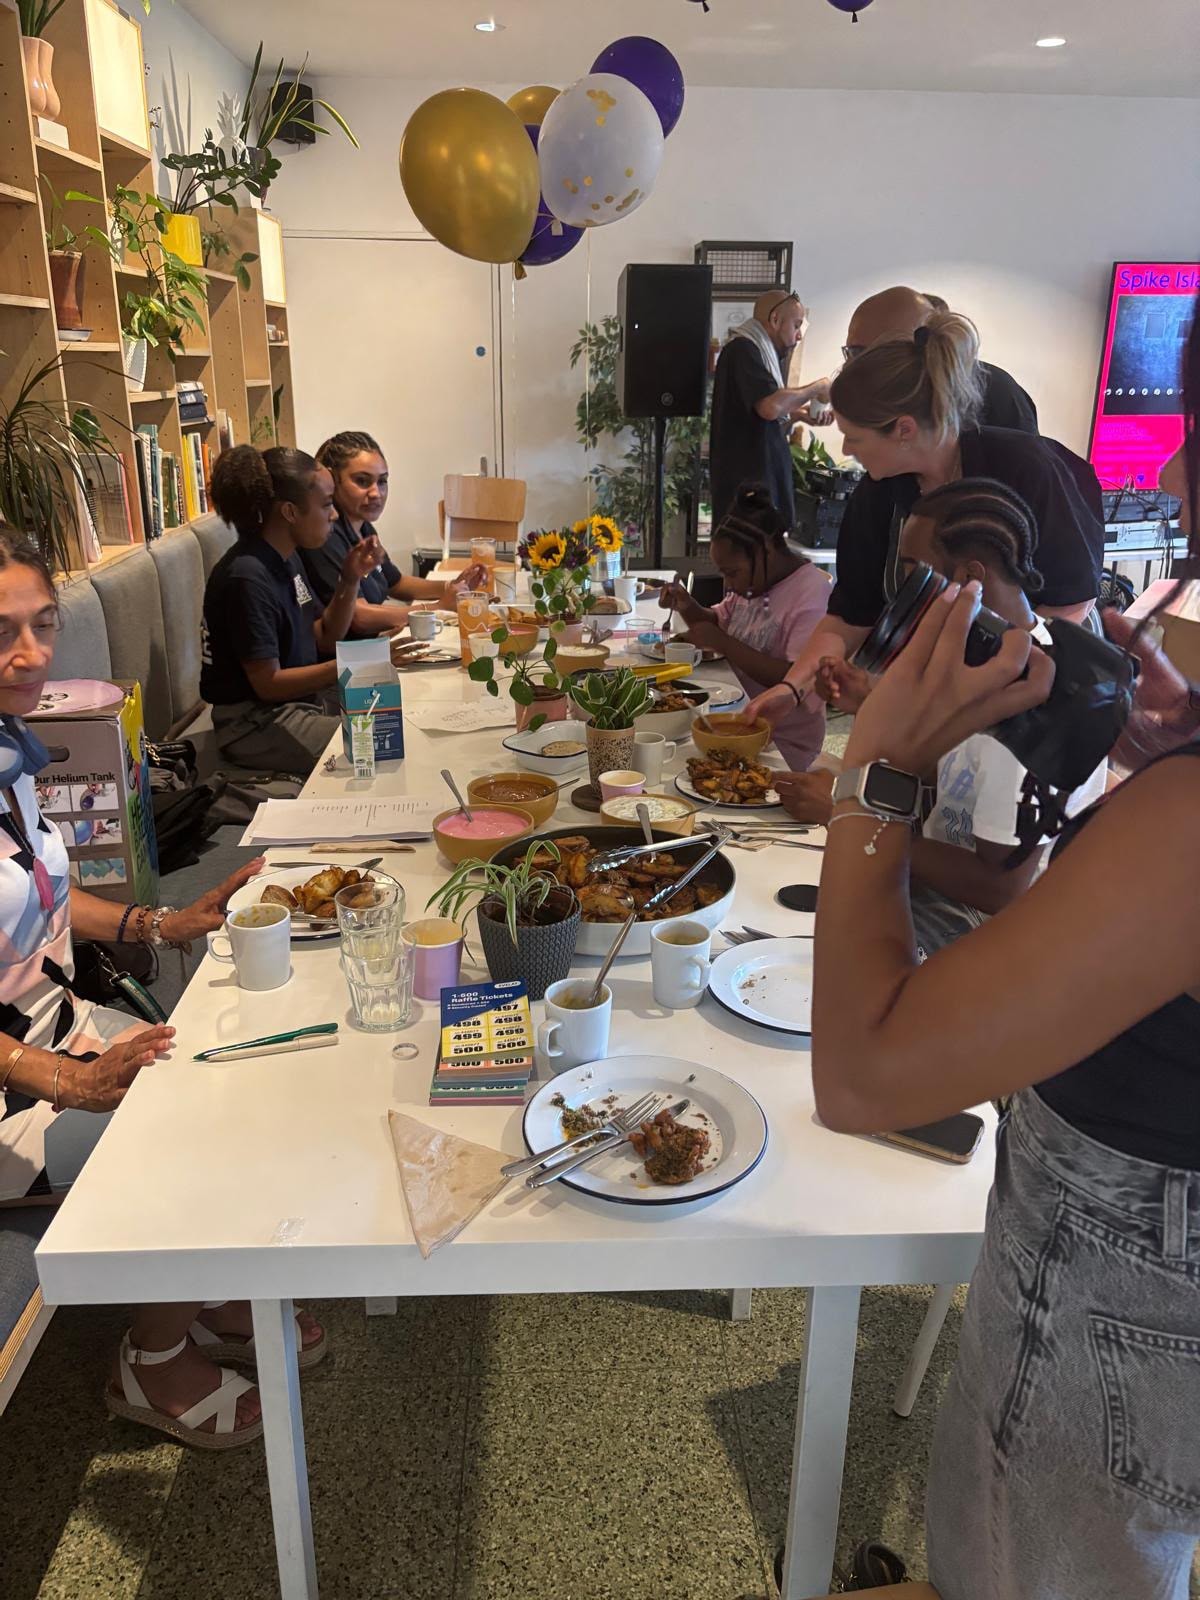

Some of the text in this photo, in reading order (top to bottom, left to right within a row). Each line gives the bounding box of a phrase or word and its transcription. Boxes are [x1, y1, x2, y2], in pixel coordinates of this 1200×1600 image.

[1120, 270, 1170, 291] Spike
[52, 774, 89, 783] Helium
[90, 772, 115, 781] Tank
[494, 1016, 523, 1025] 498
[453, 1032, 482, 1041] 499
[496, 1040, 526, 1049] 500
[453, 1045, 484, 1054] 500
